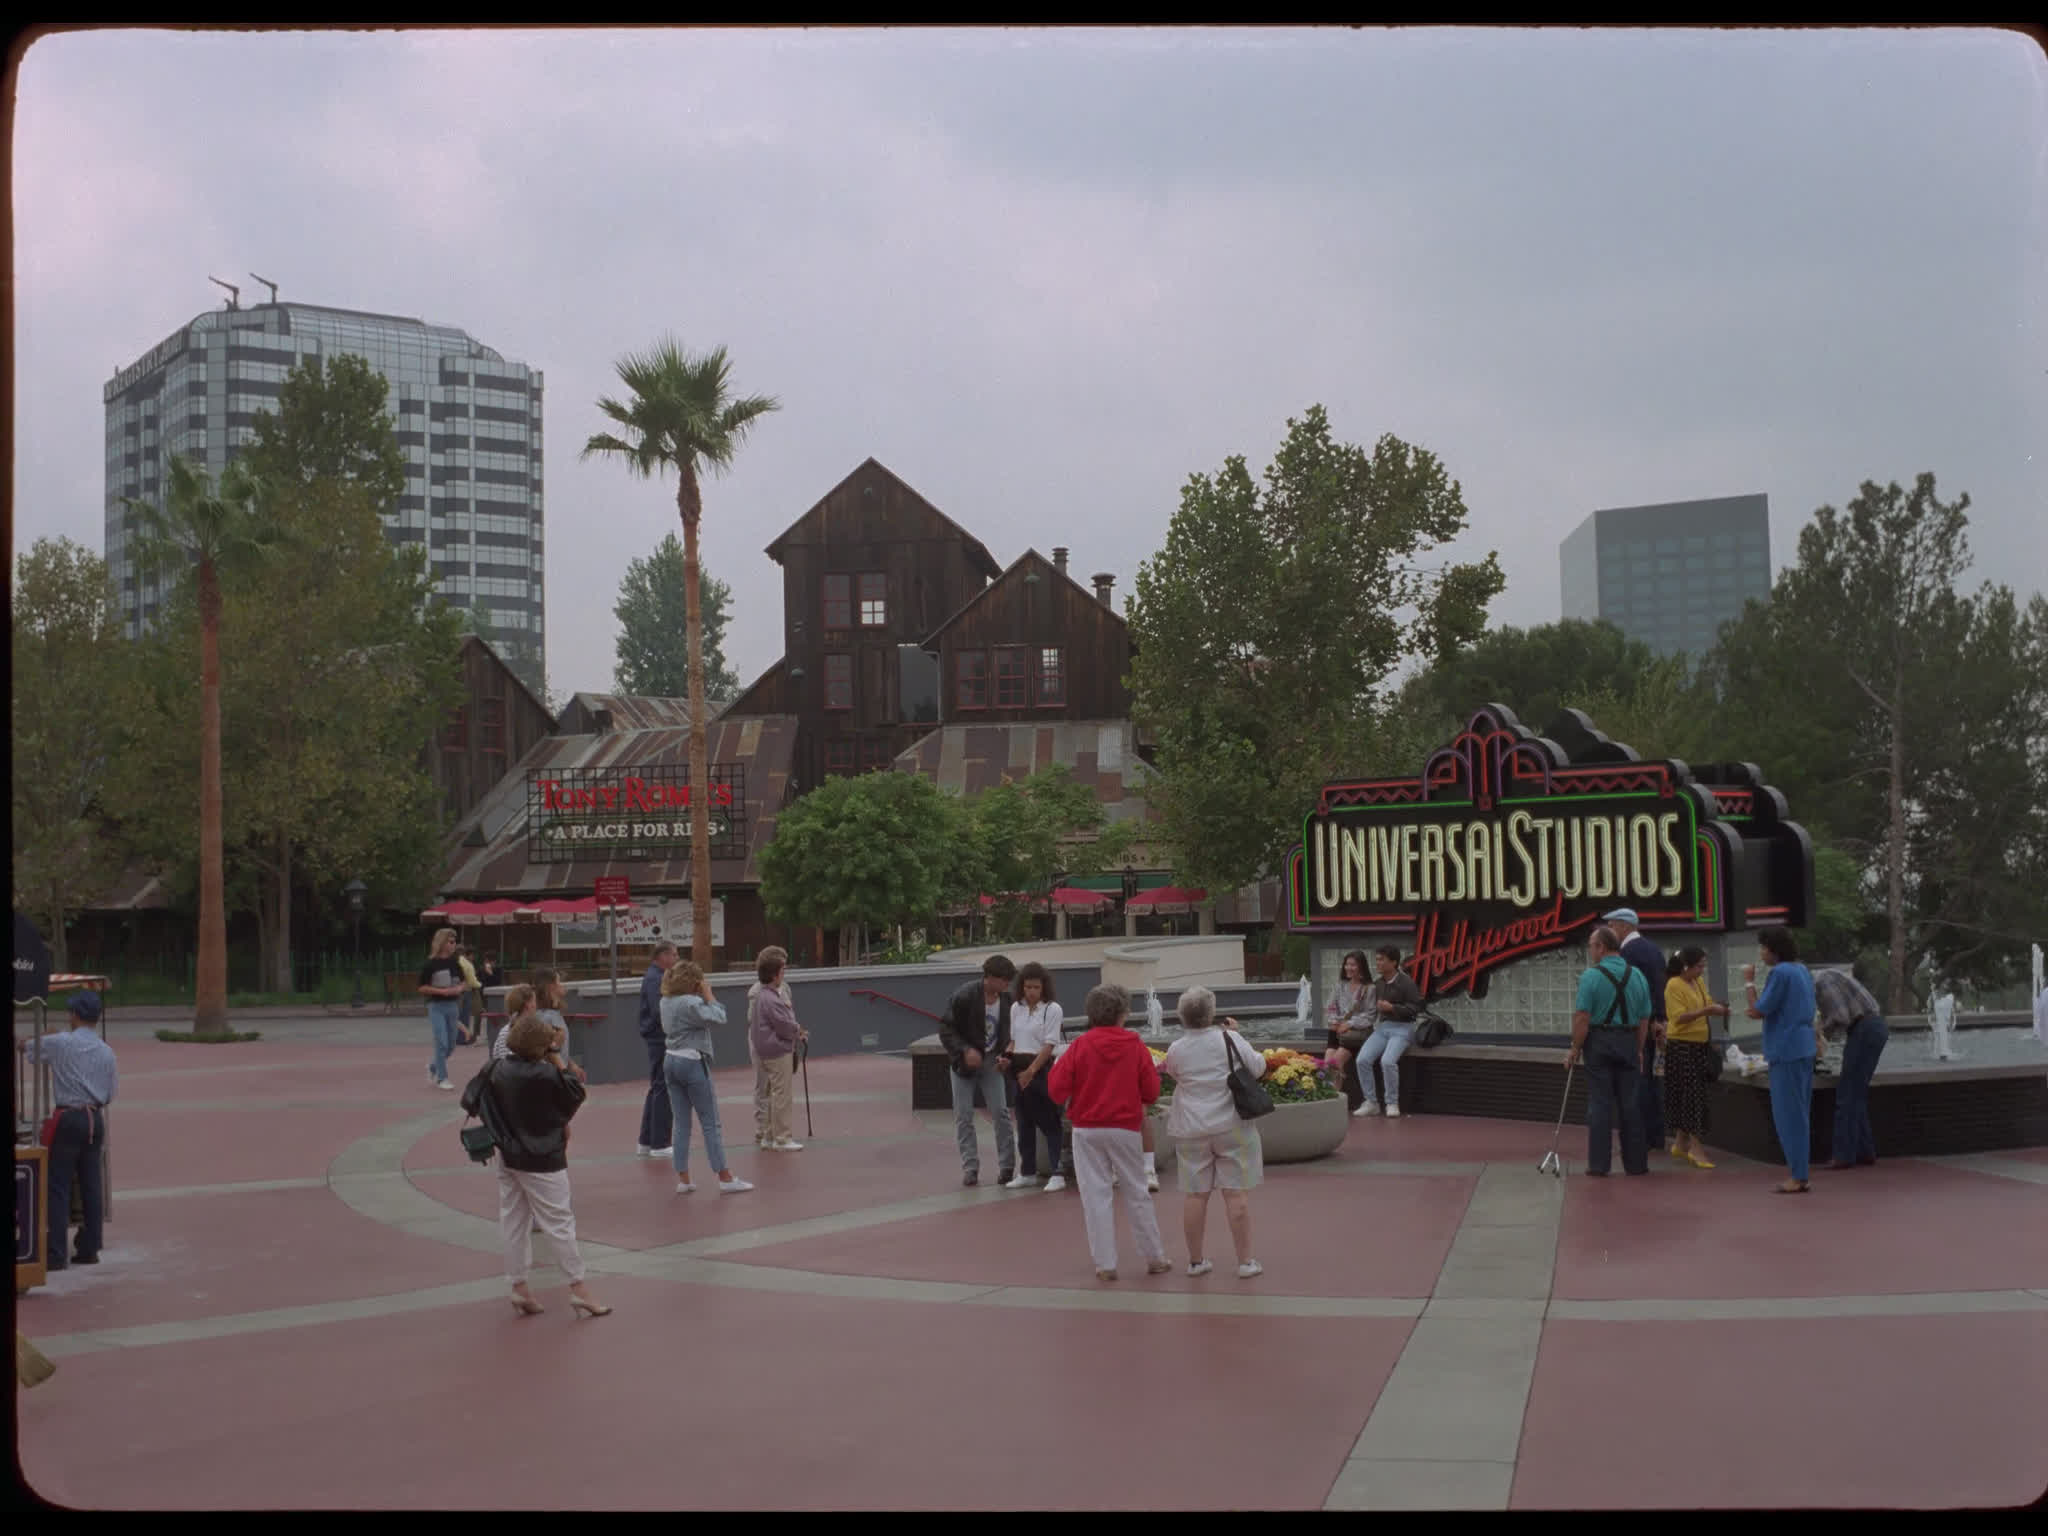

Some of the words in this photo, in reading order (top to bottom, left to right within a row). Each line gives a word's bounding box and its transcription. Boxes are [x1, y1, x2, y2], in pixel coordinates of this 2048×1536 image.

[536, 779, 619, 810] TONY
[624, 776, 732, 812] ROM'S
[553, 825, 567, 839] A
[571, 824, 628, 839] PLACE
[633, 823, 669, 837] FOR
[673, 822, 718, 836] RIS
[1314, 811, 1512, 908] UNIVERSAL
[1509, 809, 1682, 907] STUDIOS
[1404, 890, 1598, 1001] Hollywood
